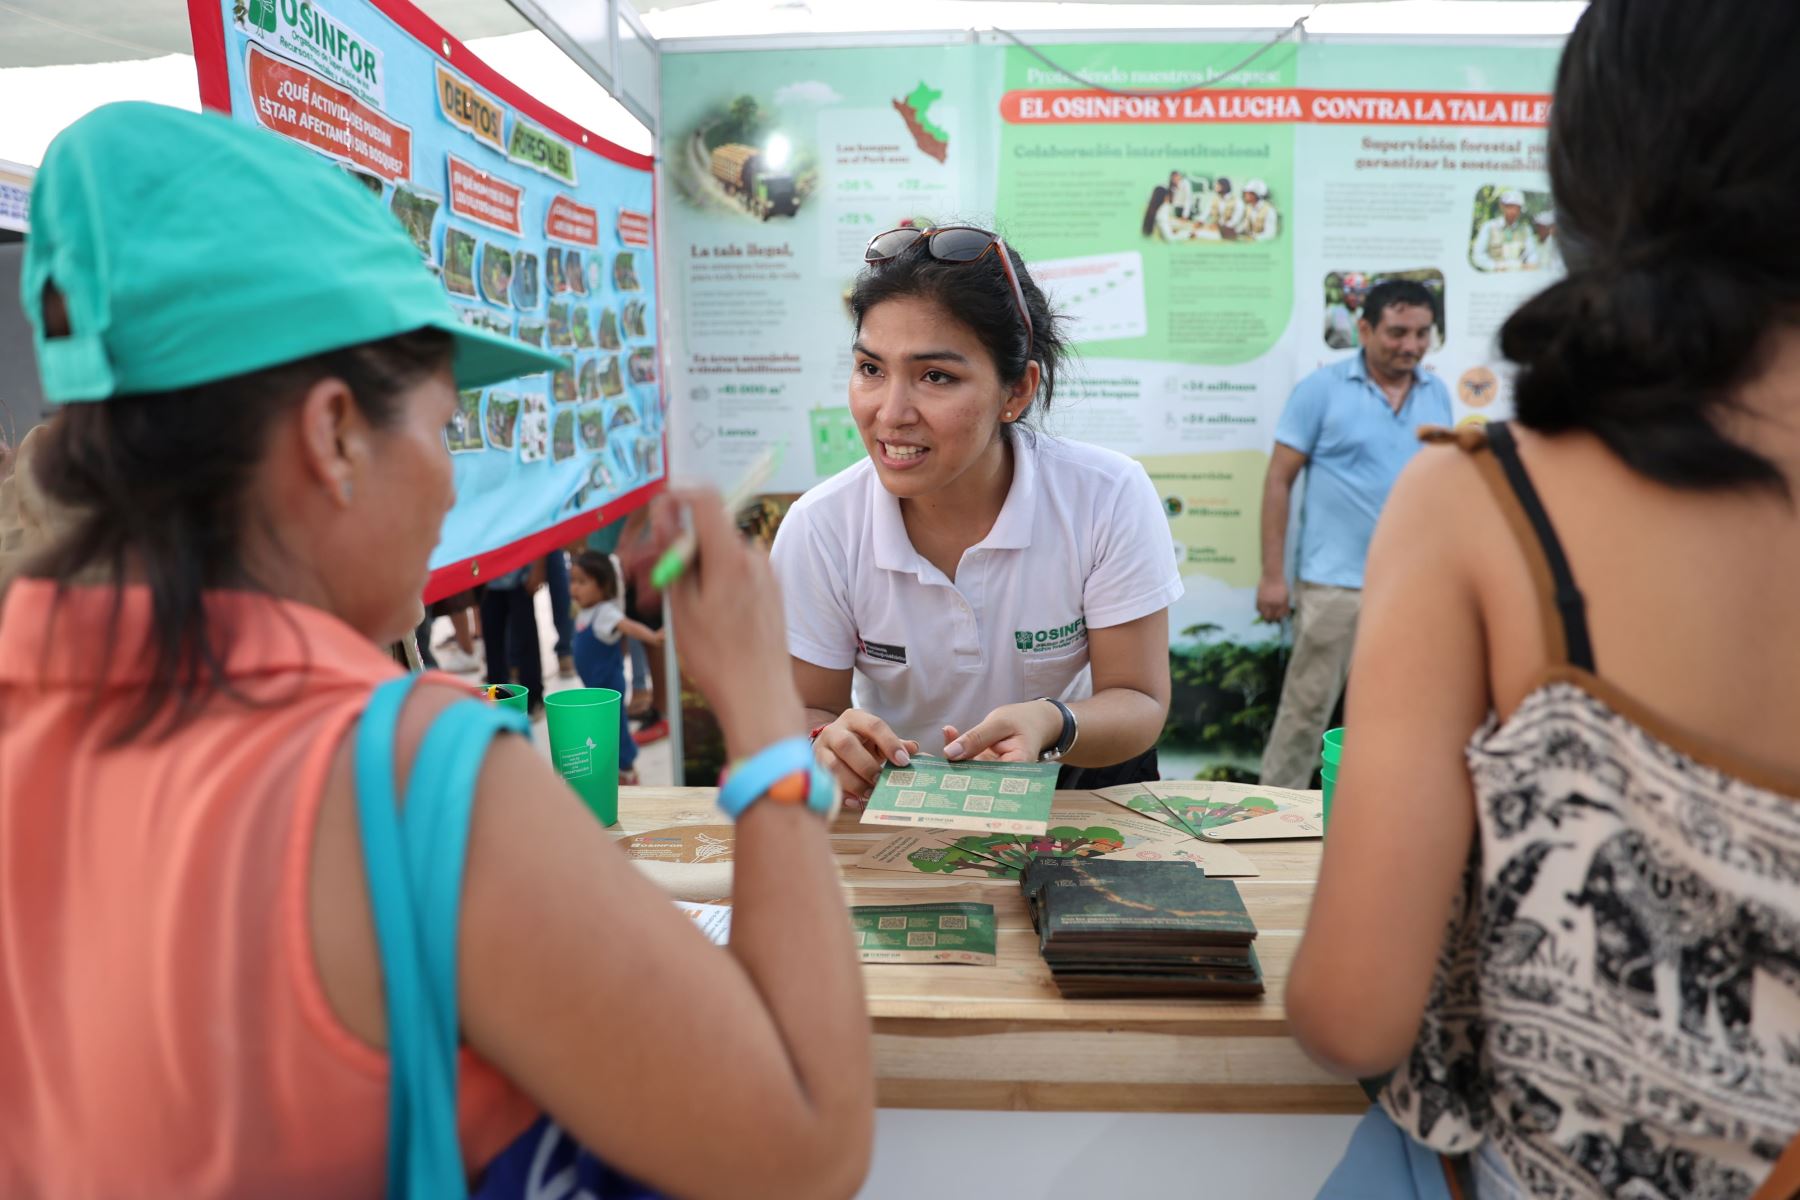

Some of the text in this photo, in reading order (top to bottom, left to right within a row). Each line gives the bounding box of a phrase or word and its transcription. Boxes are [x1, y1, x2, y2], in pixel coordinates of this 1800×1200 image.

[259, 96, 297, 124] ESTAR
[277, 80, 310, 103] ¿QUÉ
[364, 121, 392, 147] PUEDAN
[1020, 96, 1050, 119] EL
[1053, 96, 1161, 119] OSINFOR
[1165, 96, 1183, 118] Y
[1184, 96, 1220, 118] LA
[1220, 96, 1302, 118] LUCHA
[1312, 97, 1411, 120] CONTRA
[1412, 98, 1447, 120] LA
[1447, 99, 1508, 121] TALA
